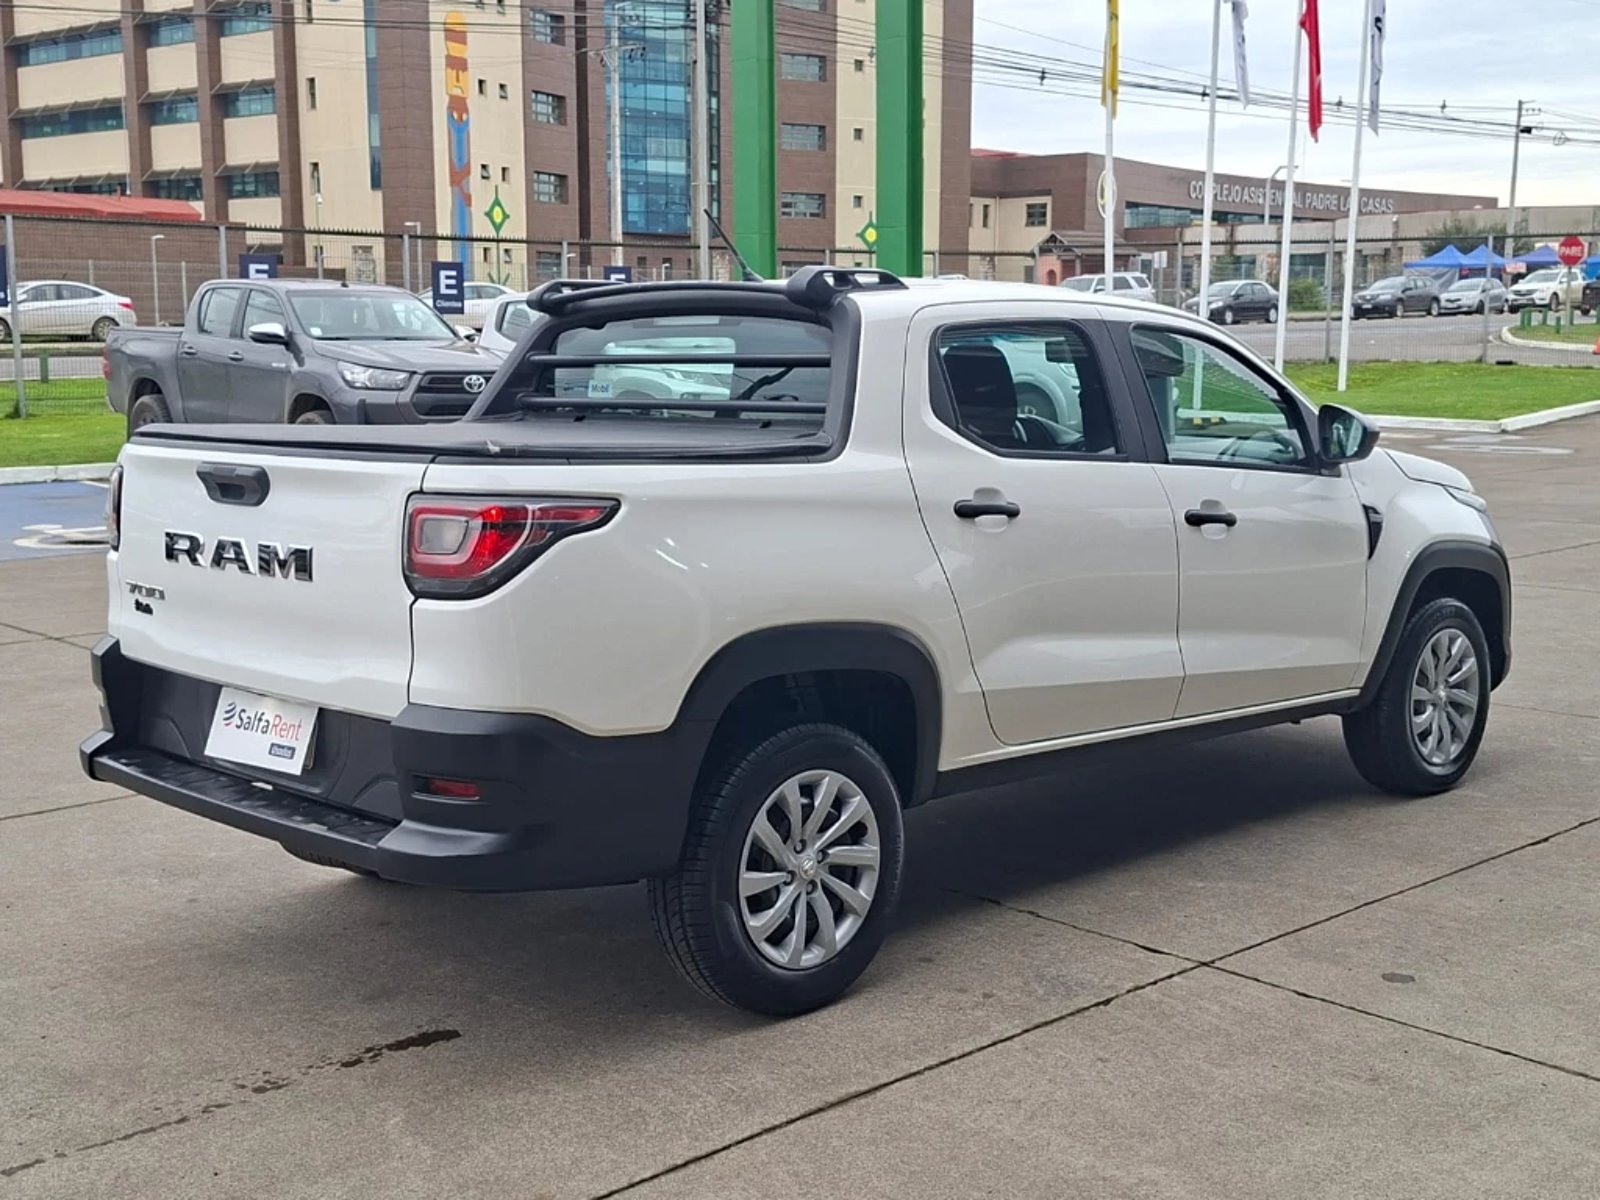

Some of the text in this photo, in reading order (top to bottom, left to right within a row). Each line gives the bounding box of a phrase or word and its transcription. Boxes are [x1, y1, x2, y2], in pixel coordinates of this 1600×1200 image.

[1189, 181, 1241, 202] COPLEJO
[1304, 192, 1338, 210] PADRE
[1360, 196, 1393, 213] CASAS
[1560, 246, 1583, 257] PARE
[439, 270, 458, 295] E
[164, 529, 314, 582] RAM
[235, 708, 303, 741] SalfaRent
